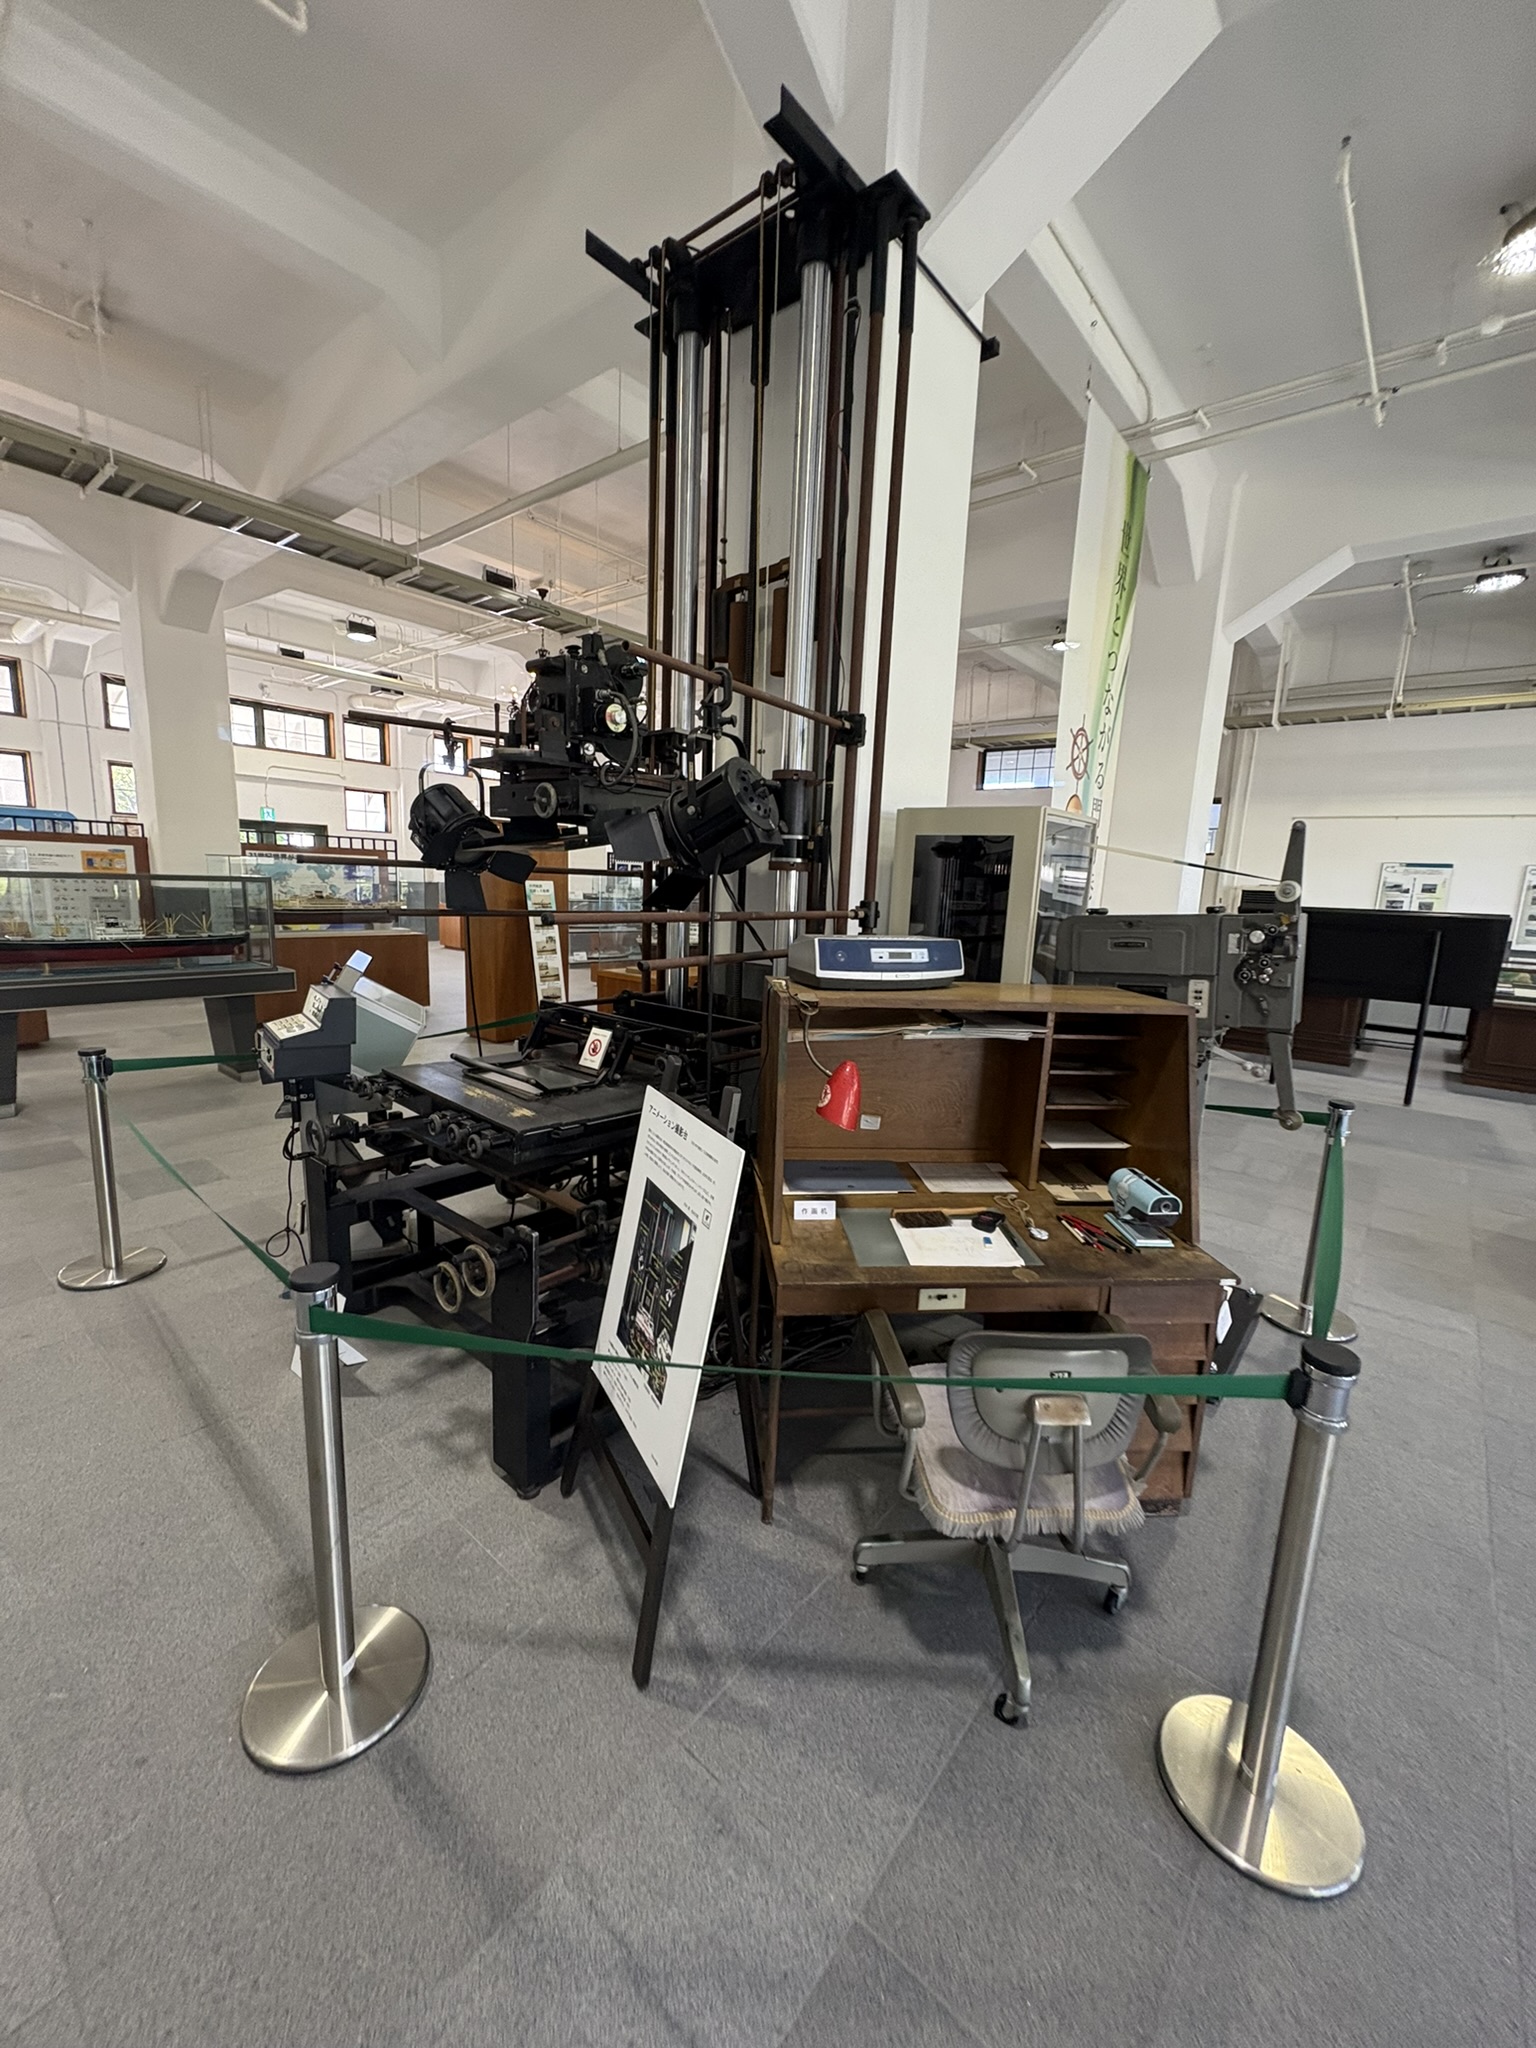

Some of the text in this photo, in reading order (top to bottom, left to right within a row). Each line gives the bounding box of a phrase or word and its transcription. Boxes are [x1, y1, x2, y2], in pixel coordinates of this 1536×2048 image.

[1090, 519, 1133, 848] 世界とつながる門
